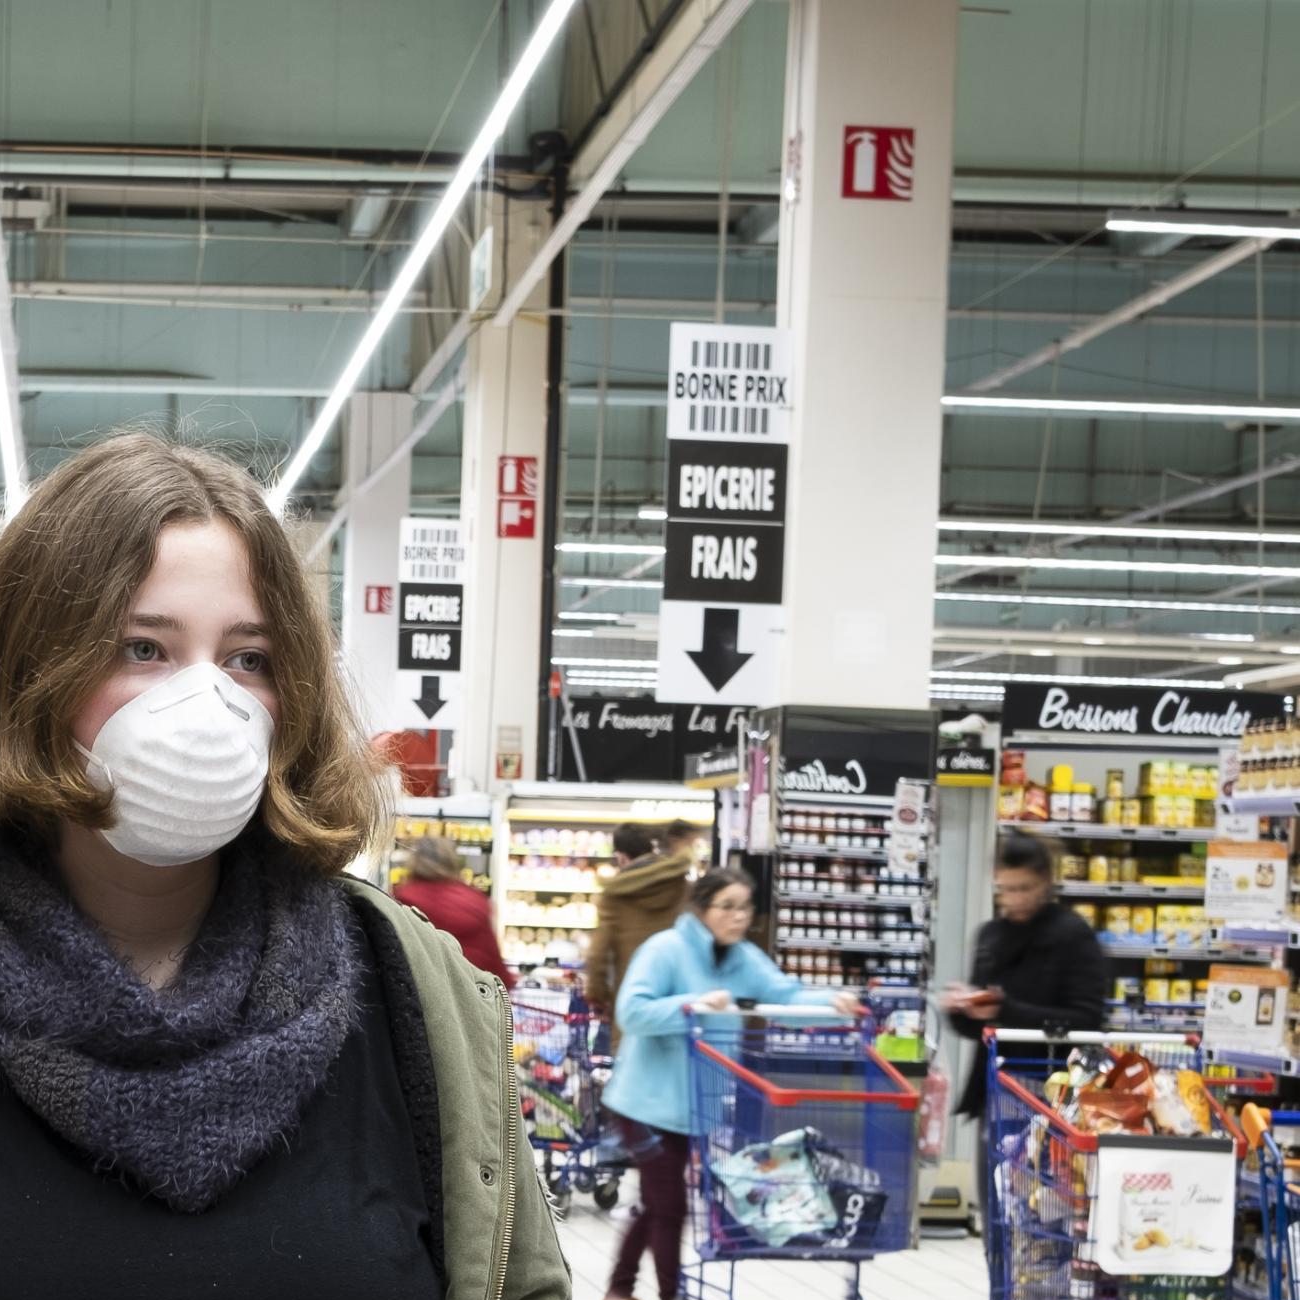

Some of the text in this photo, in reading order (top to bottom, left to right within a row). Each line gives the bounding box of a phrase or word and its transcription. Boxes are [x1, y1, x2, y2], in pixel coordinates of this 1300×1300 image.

[675, 373, 788, 404] BORNE PRIX
[679, 464, 776, 511] EPICERIE
[690, 535, 758, 581] FRAIS
[404, 594, 461, 621] EPICERIE
[411, 633, 451, 660] FRAIS
[598, 703, 674, 738] Fromages
[688, 706, 717, 733] Les
[1038, 687, 1139, 735] Boissons
